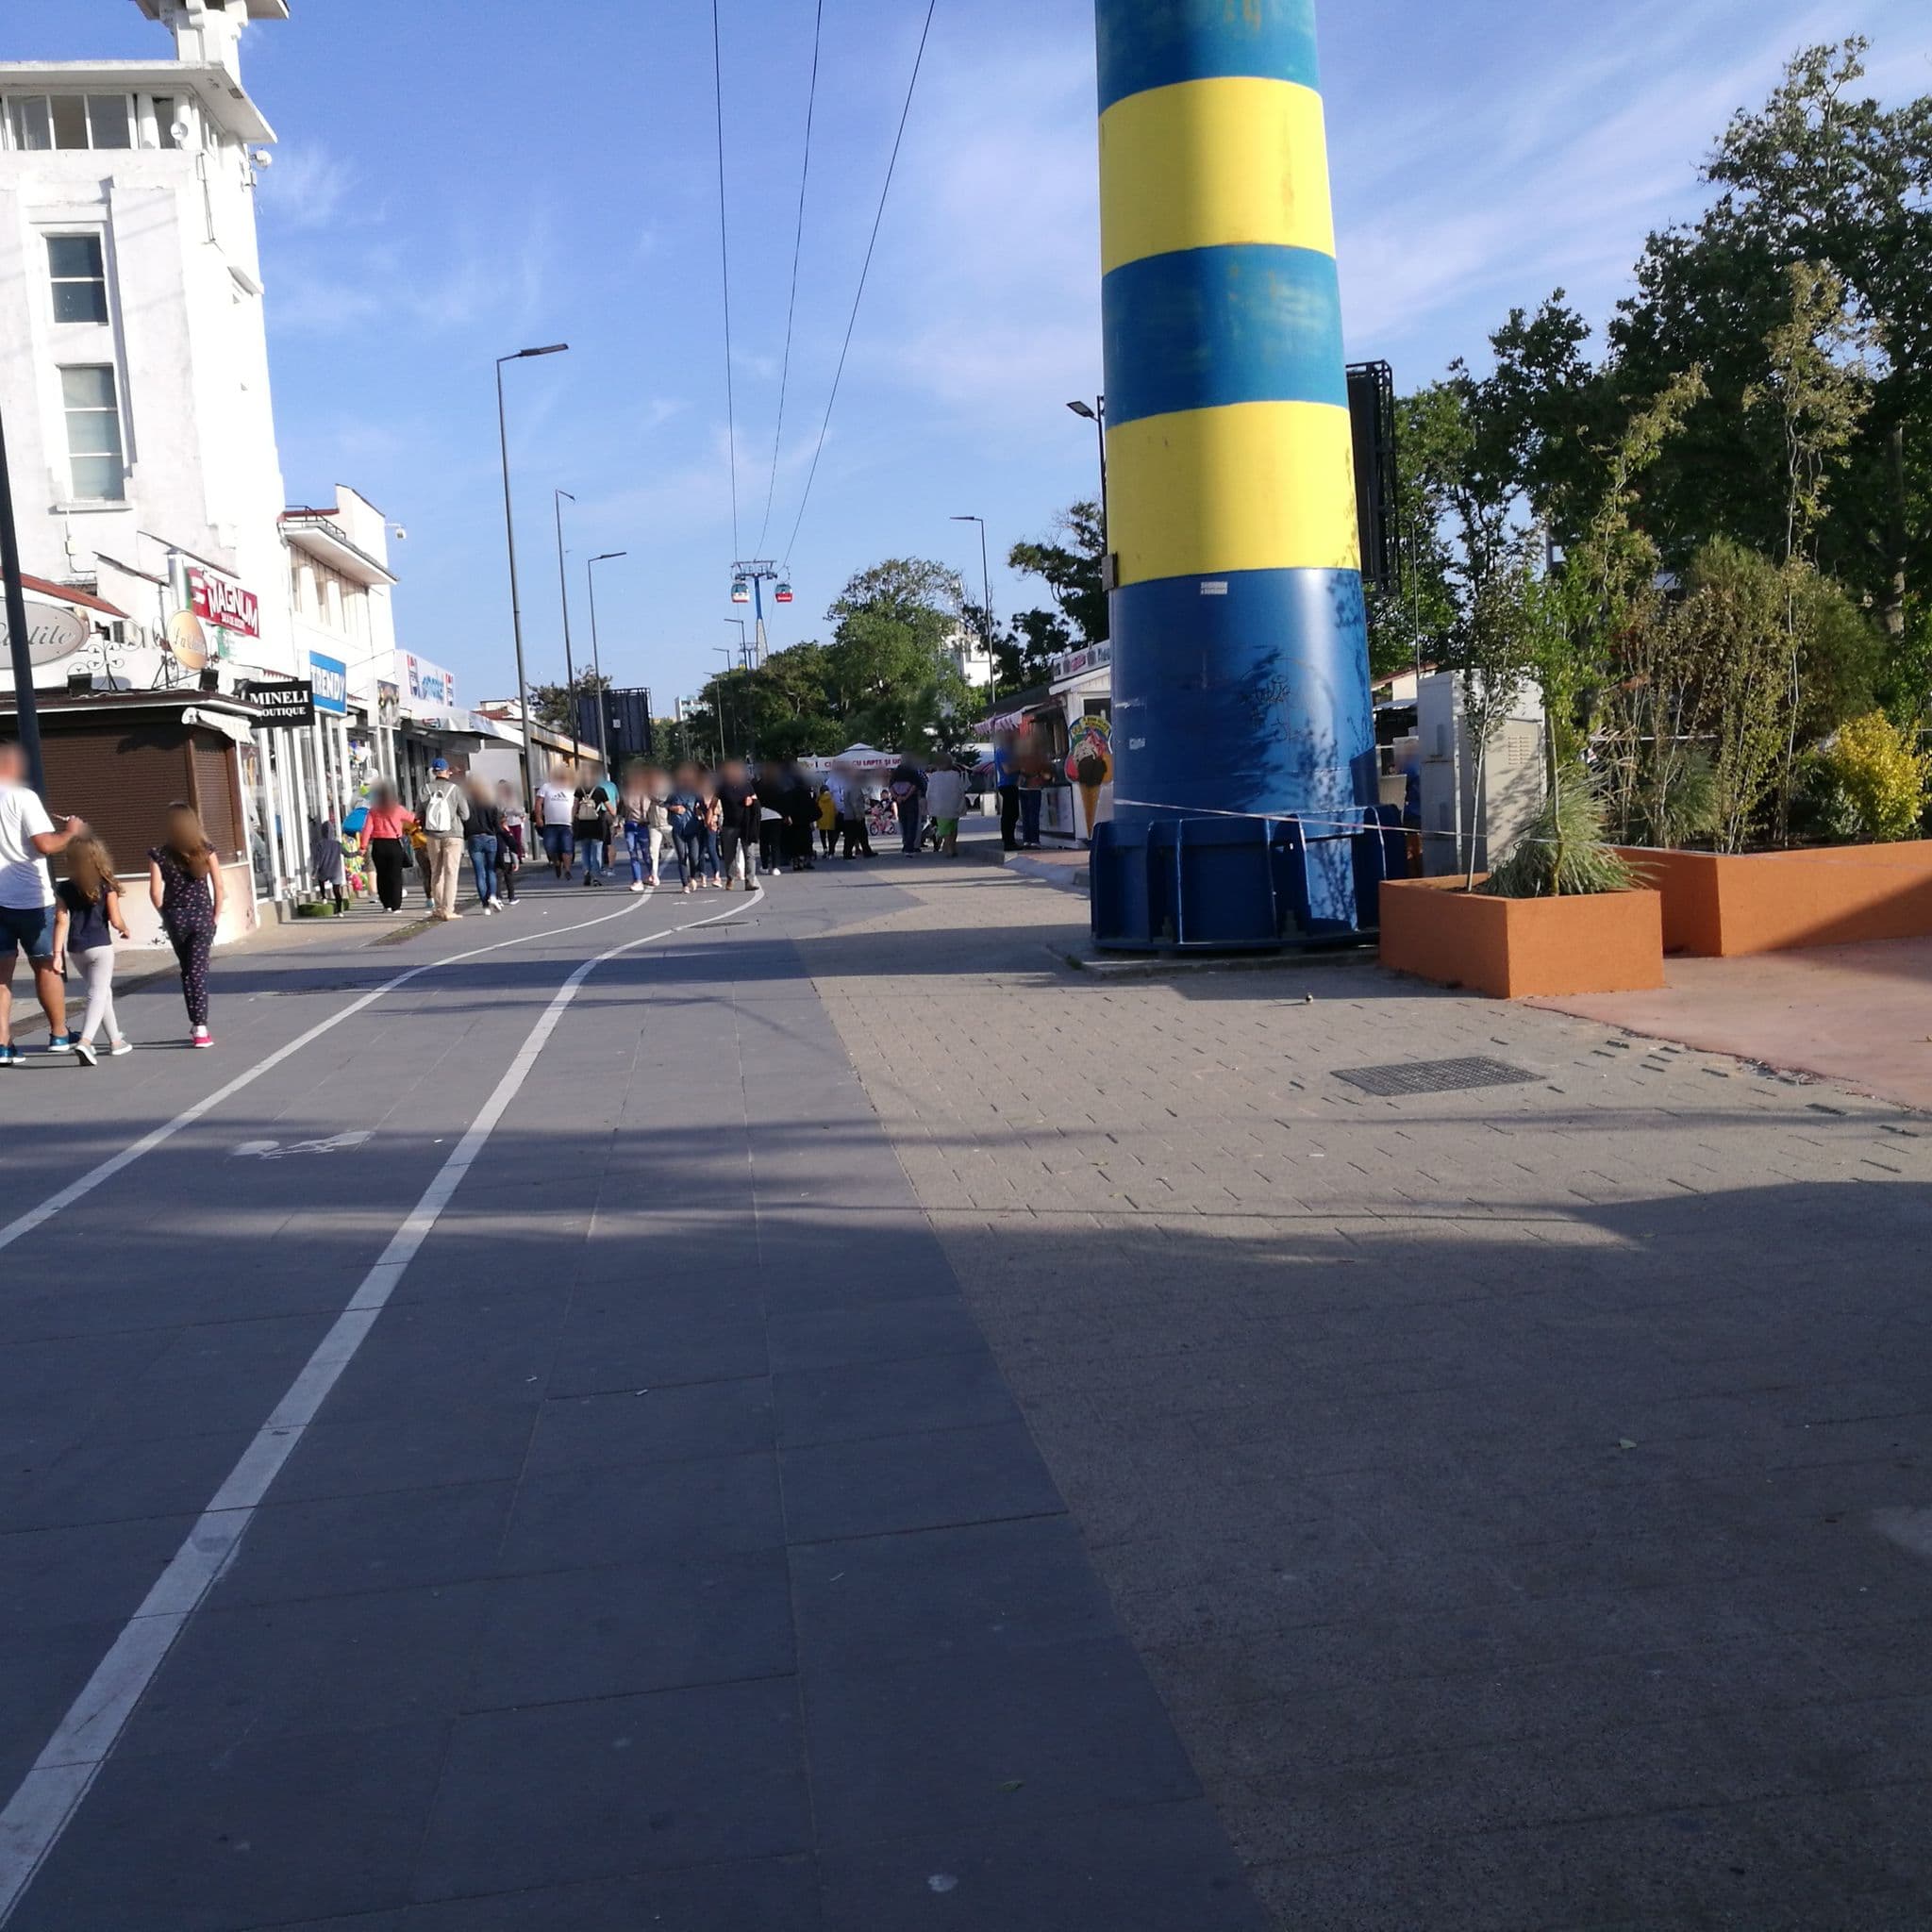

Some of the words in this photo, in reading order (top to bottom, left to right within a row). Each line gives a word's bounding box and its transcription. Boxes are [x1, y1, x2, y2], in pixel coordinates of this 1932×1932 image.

[207, 581, 258, 636] MAGNUM
[310, 663, 345, 703] TRENDY
[249, 690, 309, 706] MINELI
[259, 707, 307, 718] OUTIQUE
